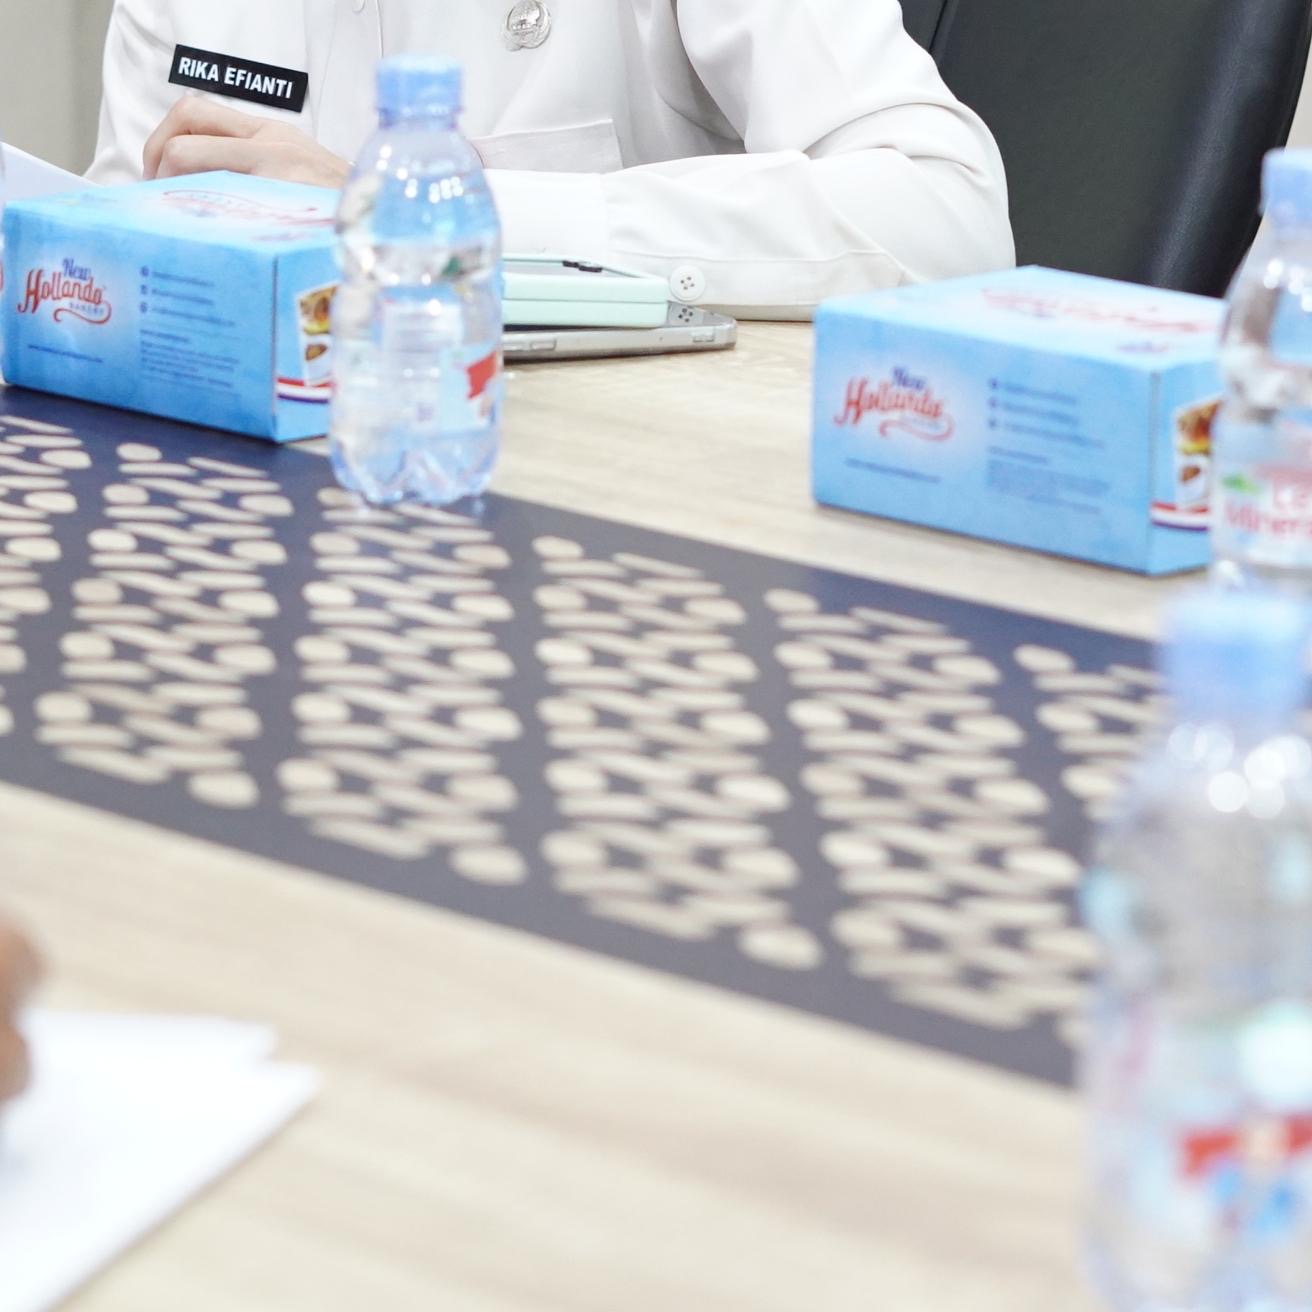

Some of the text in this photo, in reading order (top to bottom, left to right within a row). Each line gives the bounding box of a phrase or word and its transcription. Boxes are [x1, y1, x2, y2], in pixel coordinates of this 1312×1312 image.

[178, 56, 293, 99] RIKA EFIANTI
[62, 257, 91, 281] New
[16, 268, 103, 315] Hollando
